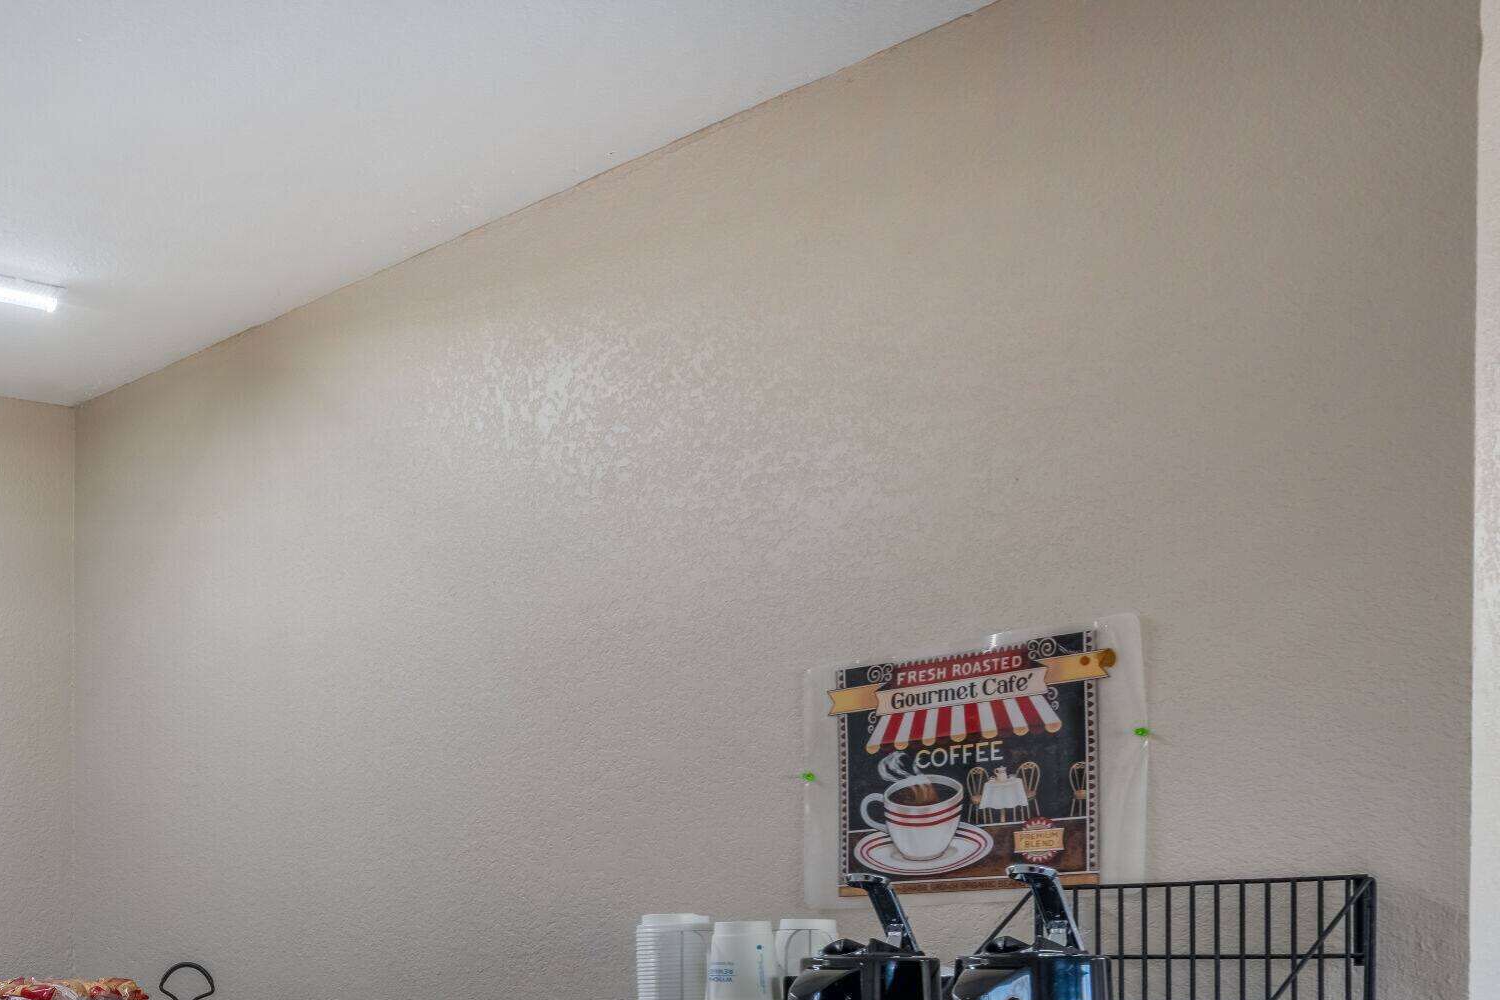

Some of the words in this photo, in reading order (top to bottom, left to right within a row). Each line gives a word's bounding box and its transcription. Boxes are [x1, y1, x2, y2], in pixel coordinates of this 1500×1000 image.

[897, 667, 947, 686] FRESH
[952, 655, 1023, 678] ROASTED
[891, 682, 979, 710] Gourmet
[915, 741, 1004, 769] COFFEE
